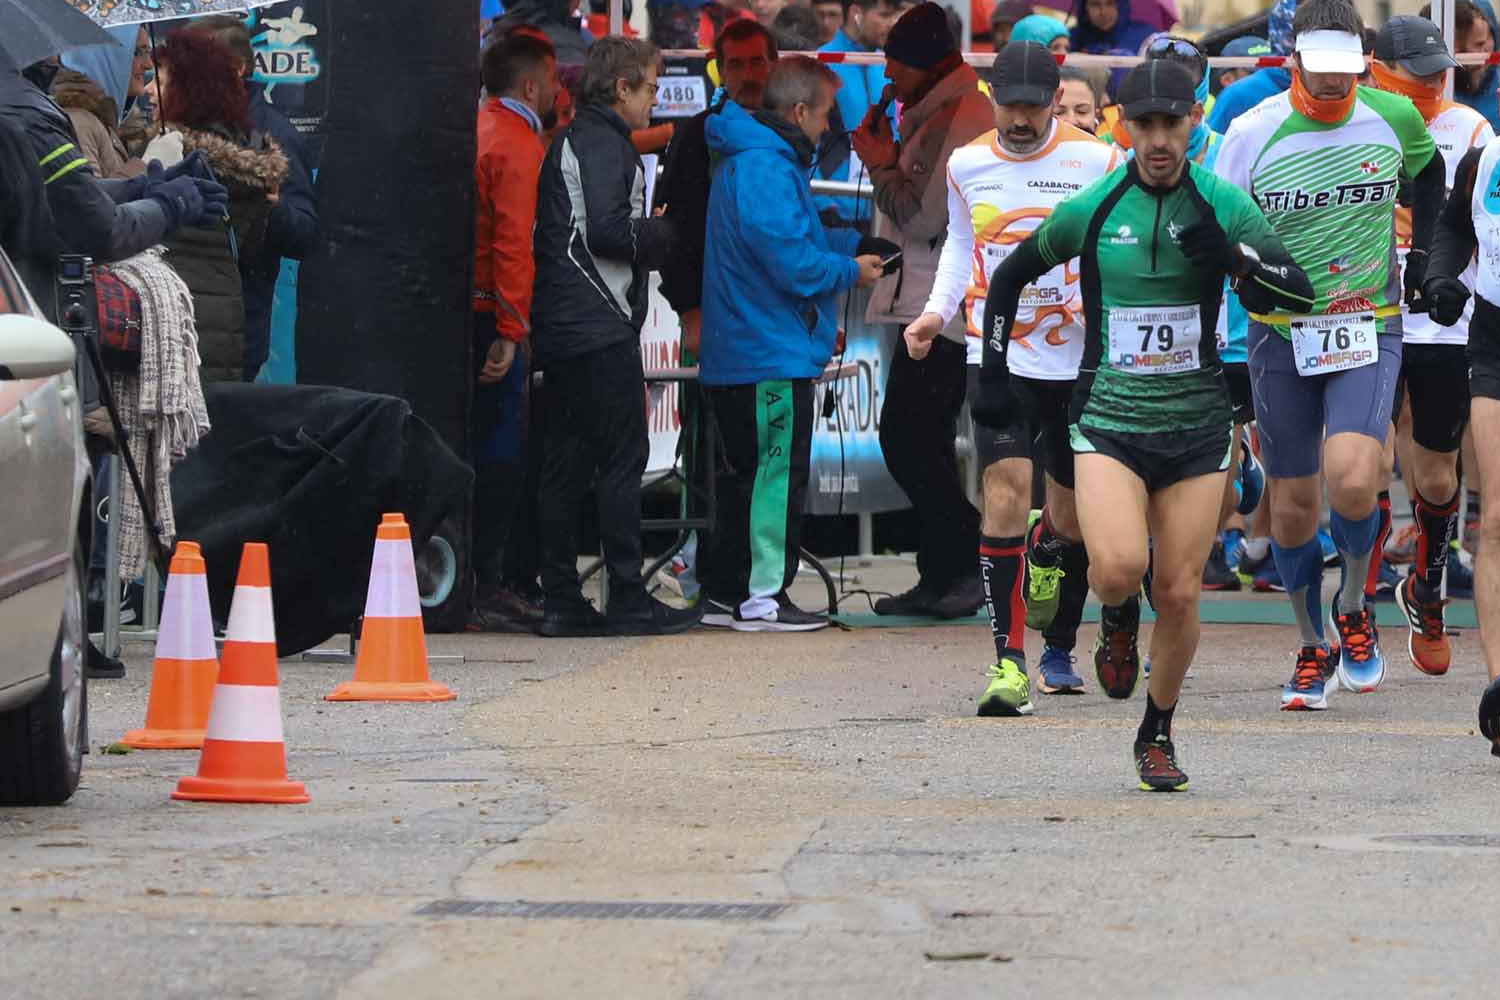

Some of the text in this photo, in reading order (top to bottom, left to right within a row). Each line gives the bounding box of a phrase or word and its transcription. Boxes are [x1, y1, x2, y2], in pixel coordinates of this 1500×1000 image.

[662, 86, 695, 102] 480
[1137, 324, 1174, 353] 79
[1317, 326, 1351, 353] 76
[1354, 329, 1367, 344] B
